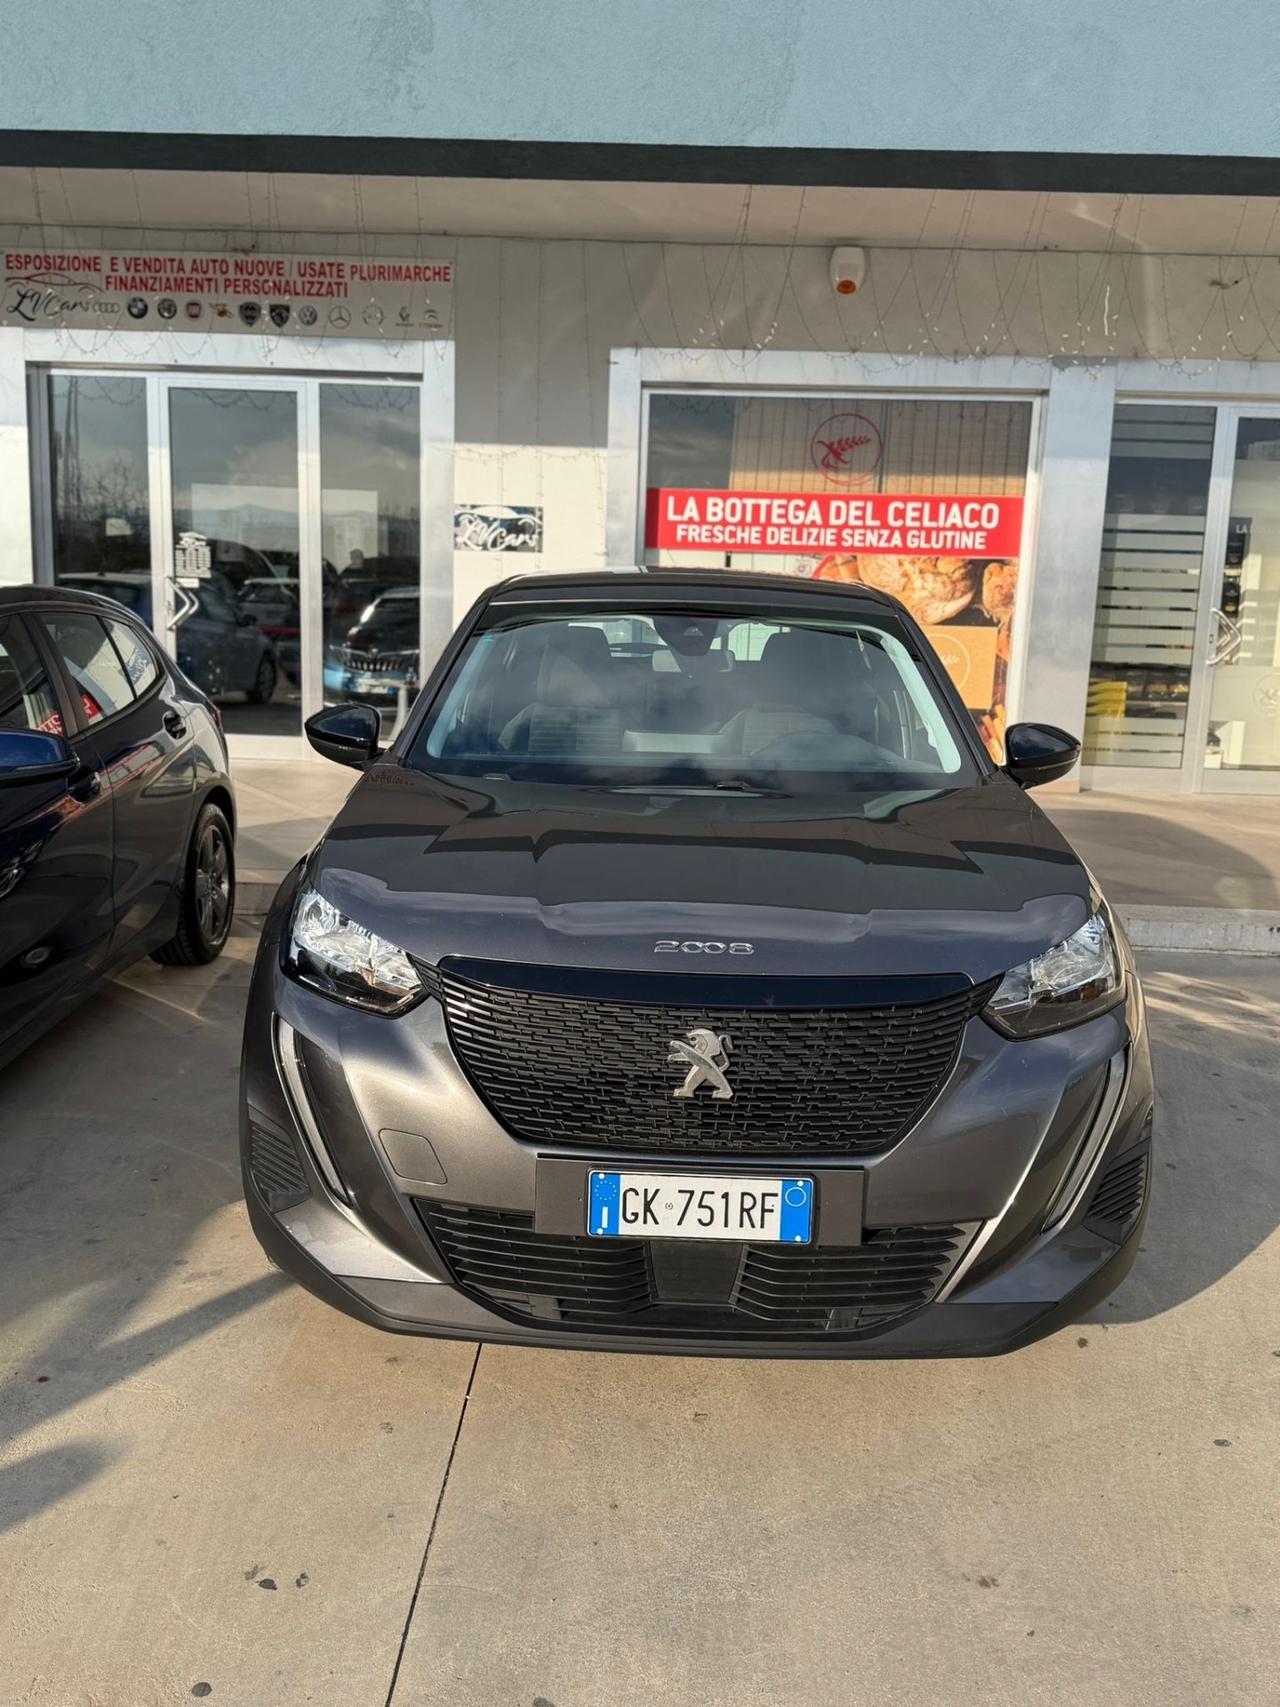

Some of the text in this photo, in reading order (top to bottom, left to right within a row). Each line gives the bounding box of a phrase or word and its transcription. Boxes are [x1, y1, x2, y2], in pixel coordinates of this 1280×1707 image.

[5, 254, 451, 282] ESPOSIZIONE E VENDITA AUTO NUOVE USATE PLURIMARCHE
[105, 275, 348, 298] FINANZIAMENTI PERSONALIZZATI
[667, 496, 1000, 529] LA BOTTEGA DEL CELIACO
[676, 524, 987, 549] FRESCHE DELIZIE SENZA GLUTINE
[654, 940, 754, 955] 2008
[621, 1187, 778, 1229] GK 751RF
